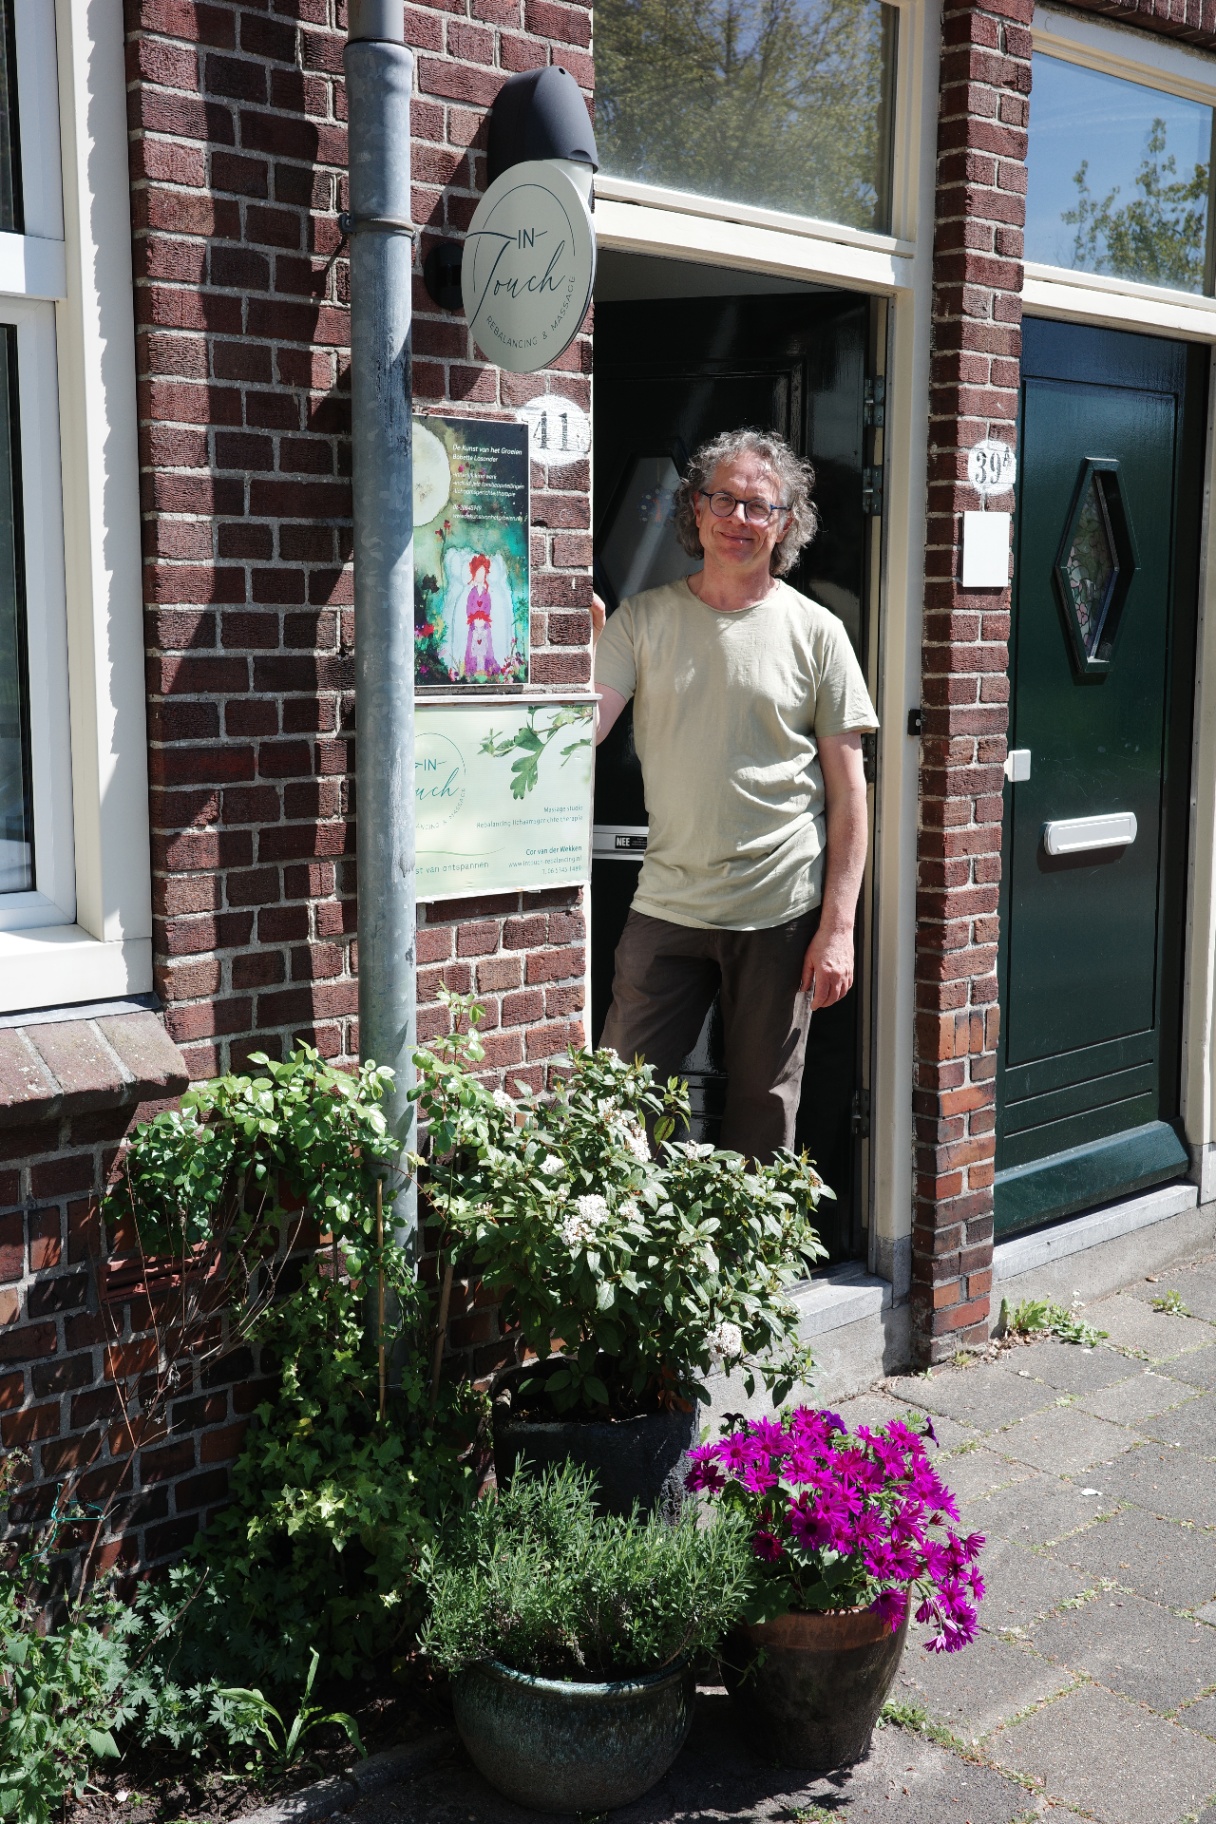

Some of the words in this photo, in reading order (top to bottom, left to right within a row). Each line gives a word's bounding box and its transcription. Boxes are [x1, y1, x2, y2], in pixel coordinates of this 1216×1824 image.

[518, 228, 535, 250] IN
[465, 231, 566, 329] Touch
[486, 315, 538, 349] REBALANCING
[551, 275, 576, 331] MASSAGE
[452, 443, 461, 451] De
[490, 446, 500, 454] het
[424, 758, 437, 771] IN
[616, 837, 631, 847] NEE
[526, 848, 537, 856] Cor
[549, 846, 559, 854] der
[442, 861, 489, 872] ontspannen
